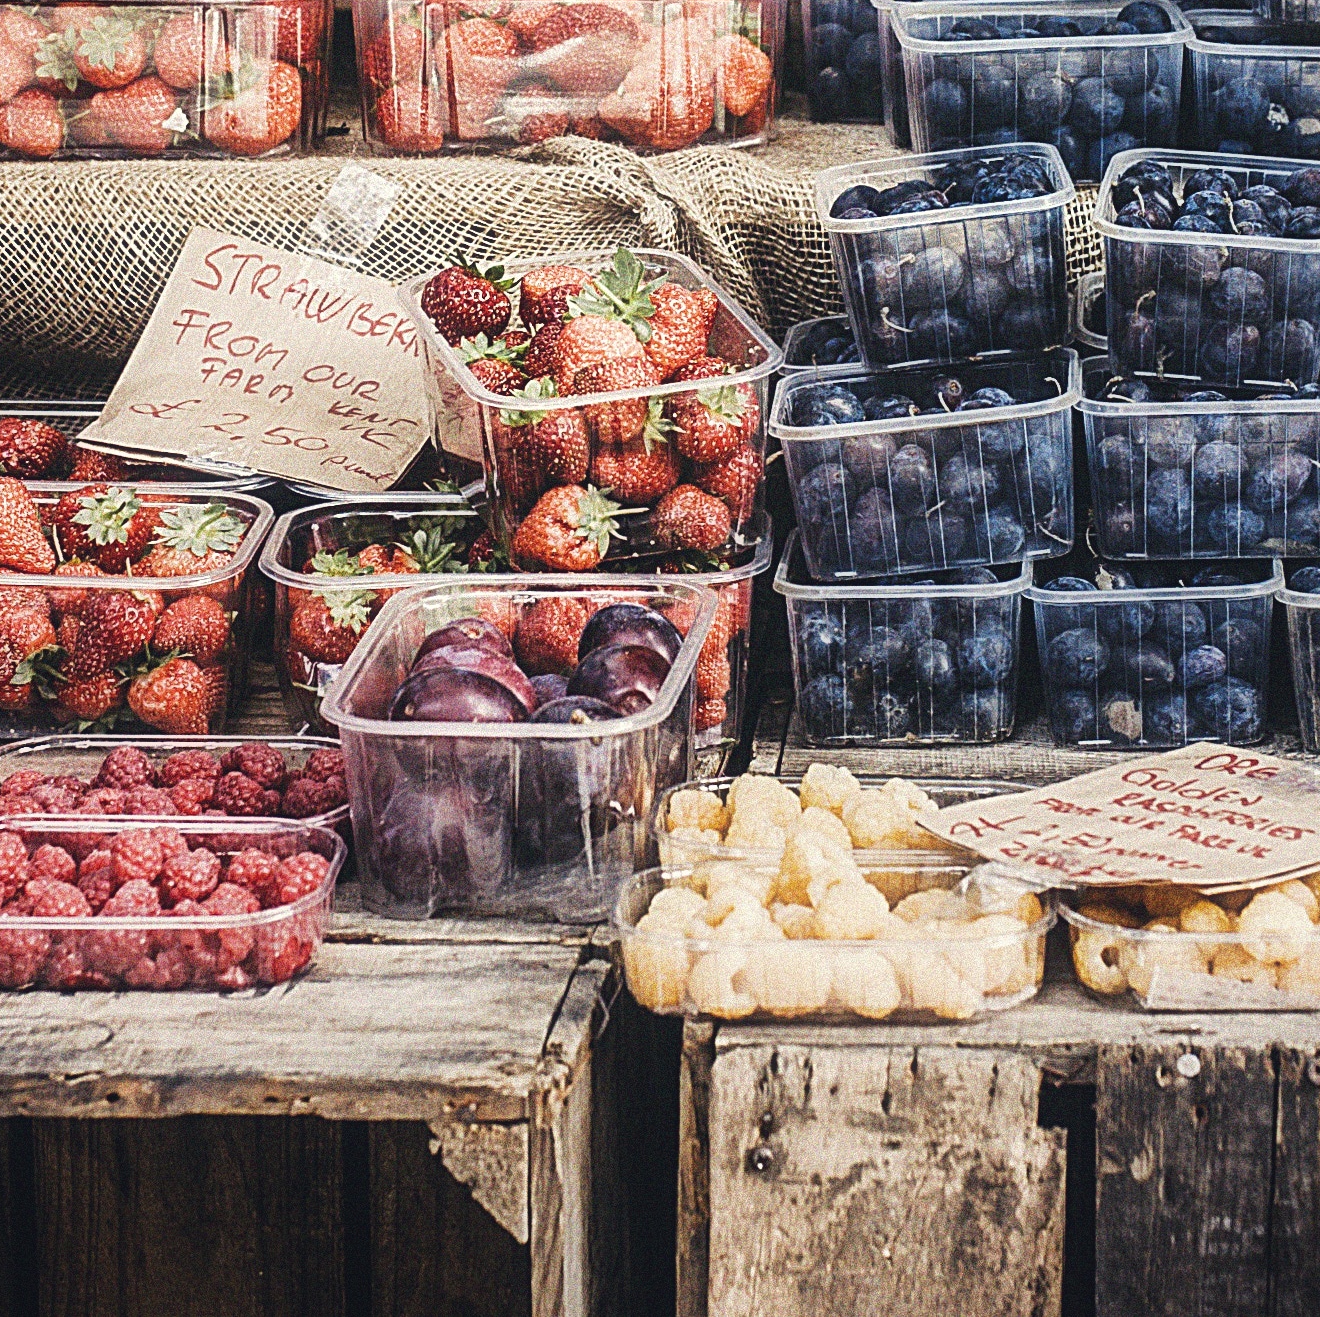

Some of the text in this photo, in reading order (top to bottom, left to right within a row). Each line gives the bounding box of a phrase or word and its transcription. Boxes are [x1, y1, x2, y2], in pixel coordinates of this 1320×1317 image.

[173, 308, 289, 371] FROM
[302, 364, 381, 402] OUR
[200, 356, 295, 404] FARM
